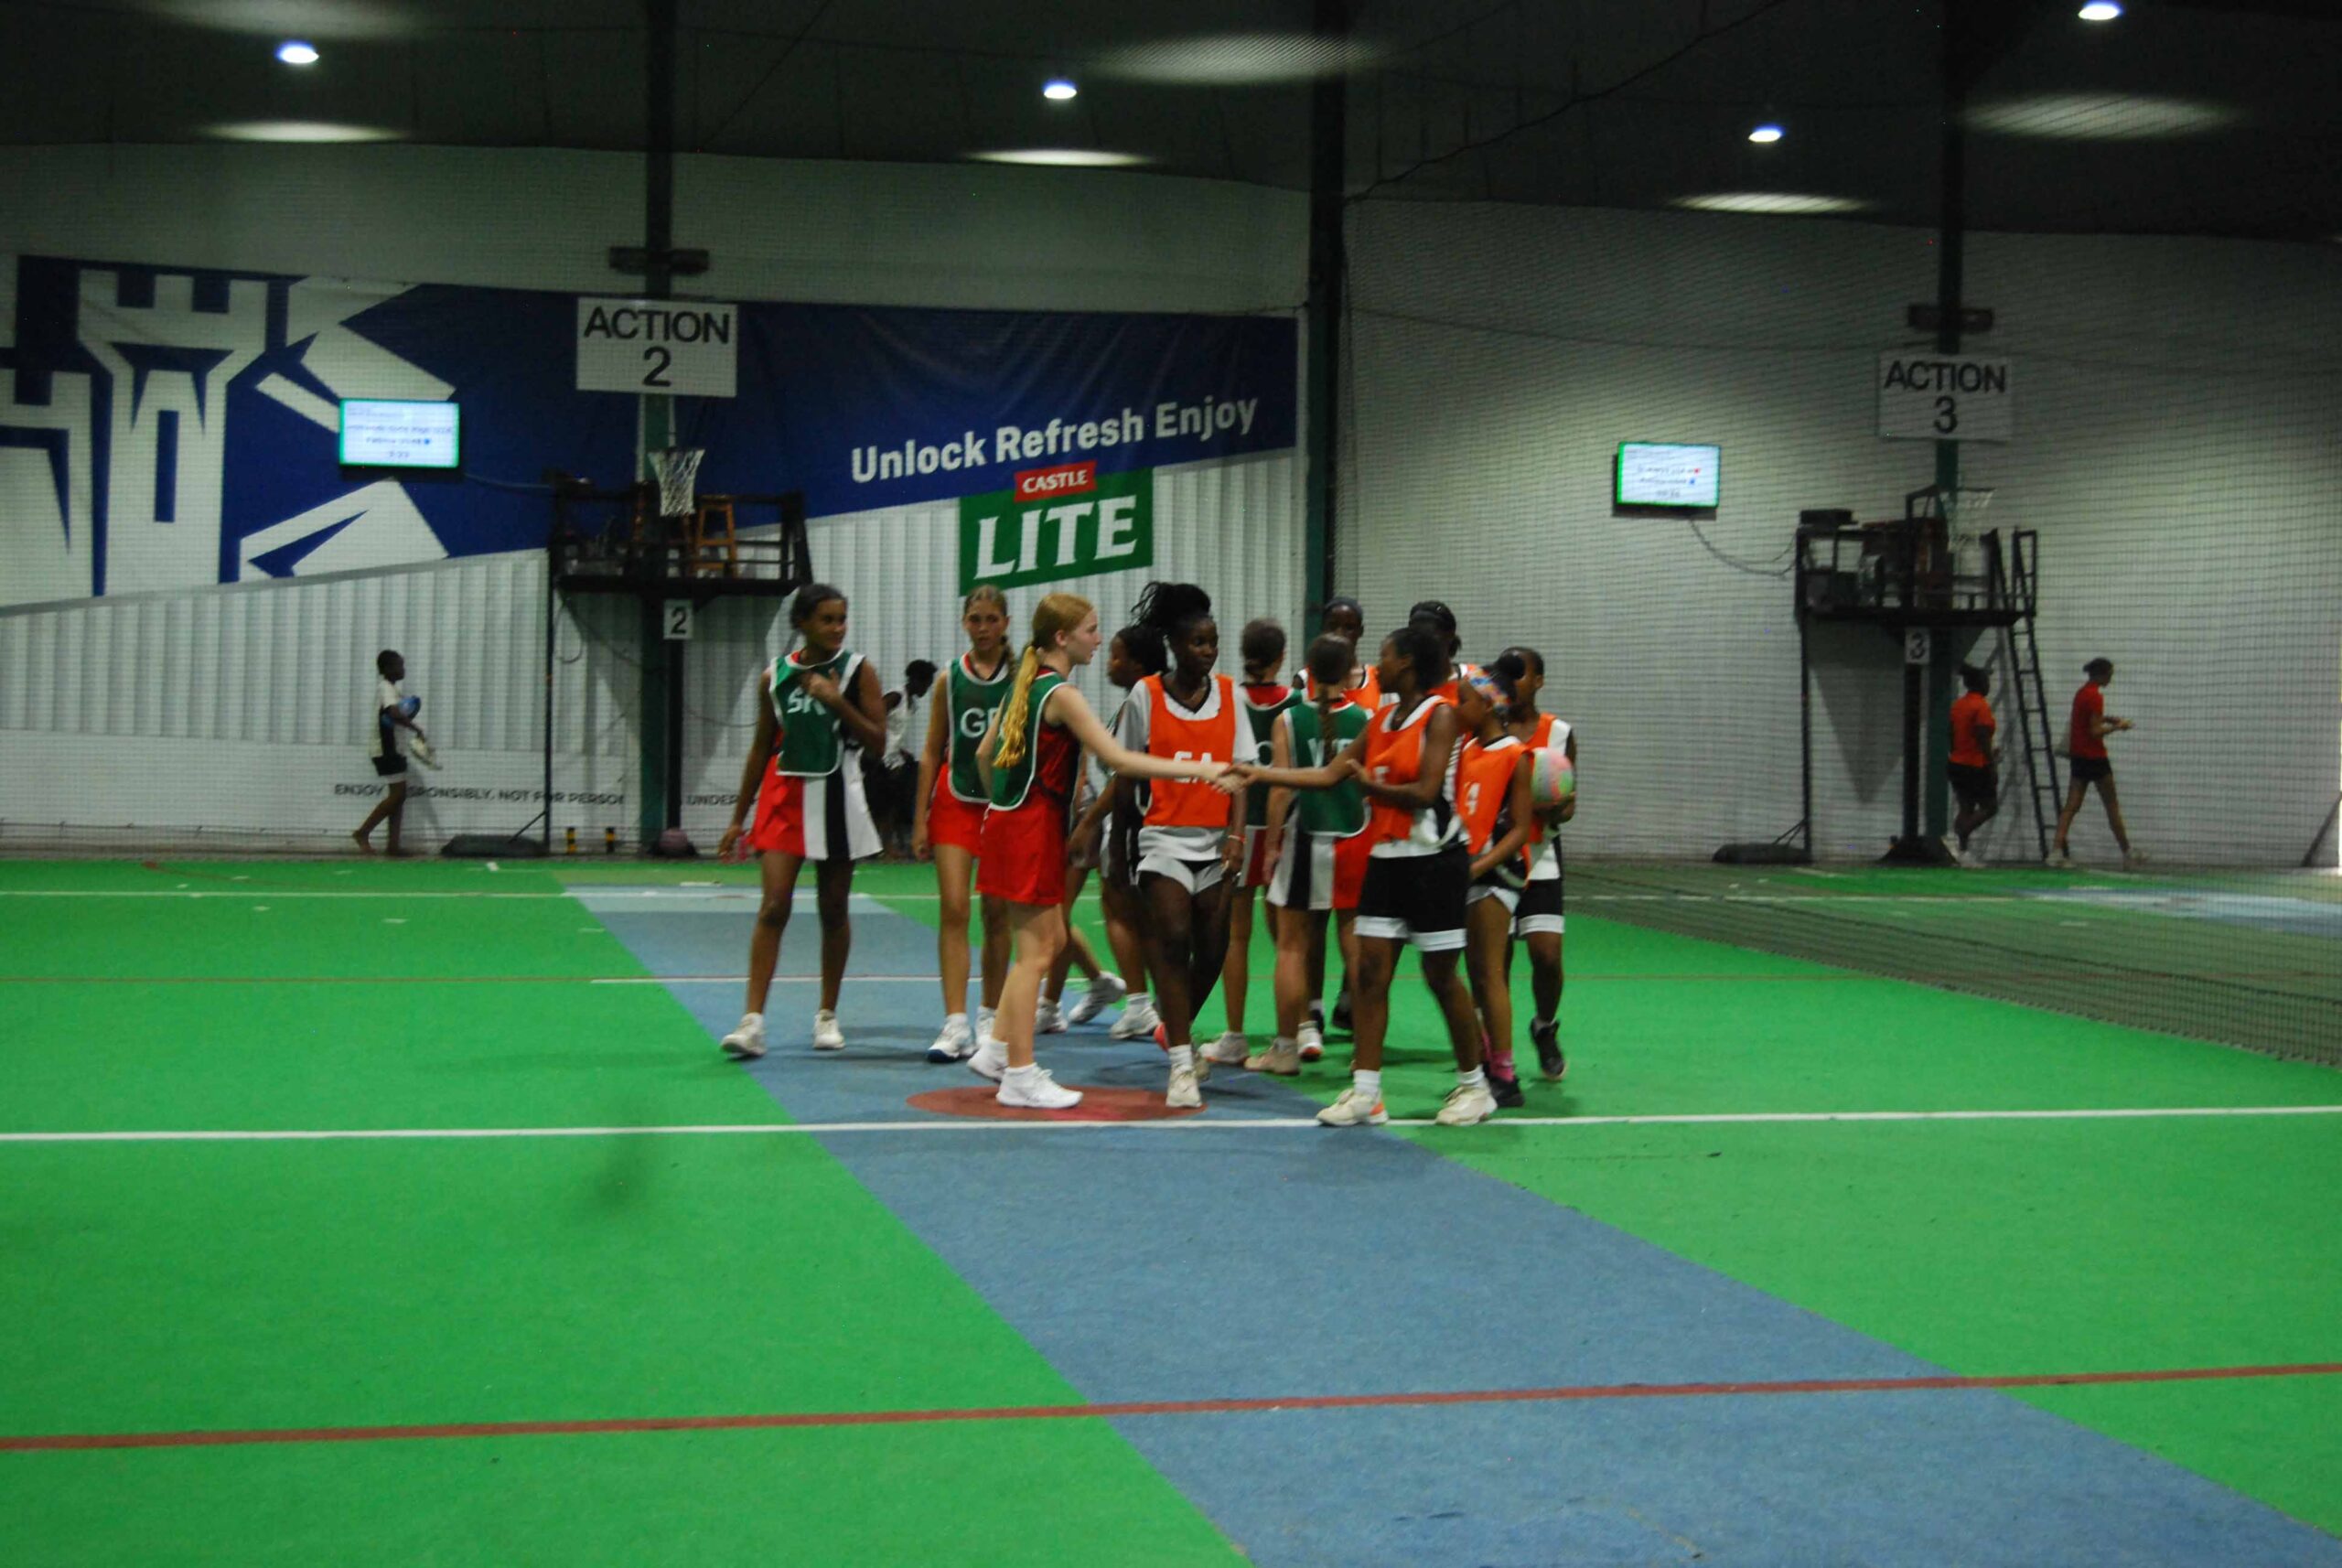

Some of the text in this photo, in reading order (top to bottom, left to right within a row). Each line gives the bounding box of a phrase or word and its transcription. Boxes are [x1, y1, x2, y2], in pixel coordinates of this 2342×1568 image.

[584, 306, 730, 344] ACTION
[643, 346, 671, 387] 2
[1884, 360, 2006, 393] ACTION
[1934, 395, 1958, 434] 3
[852, 394, 1258, 483] Unlock Refresh Enjoy
[1022, 469, 1089, 494] CASTLE
[973, 495, 1137, 580] LITE
[671, 606, 687, 634] 2
[1910, 632, 1926, 660] 3
[406, 785, 496, 802] SPONSIBLY,
